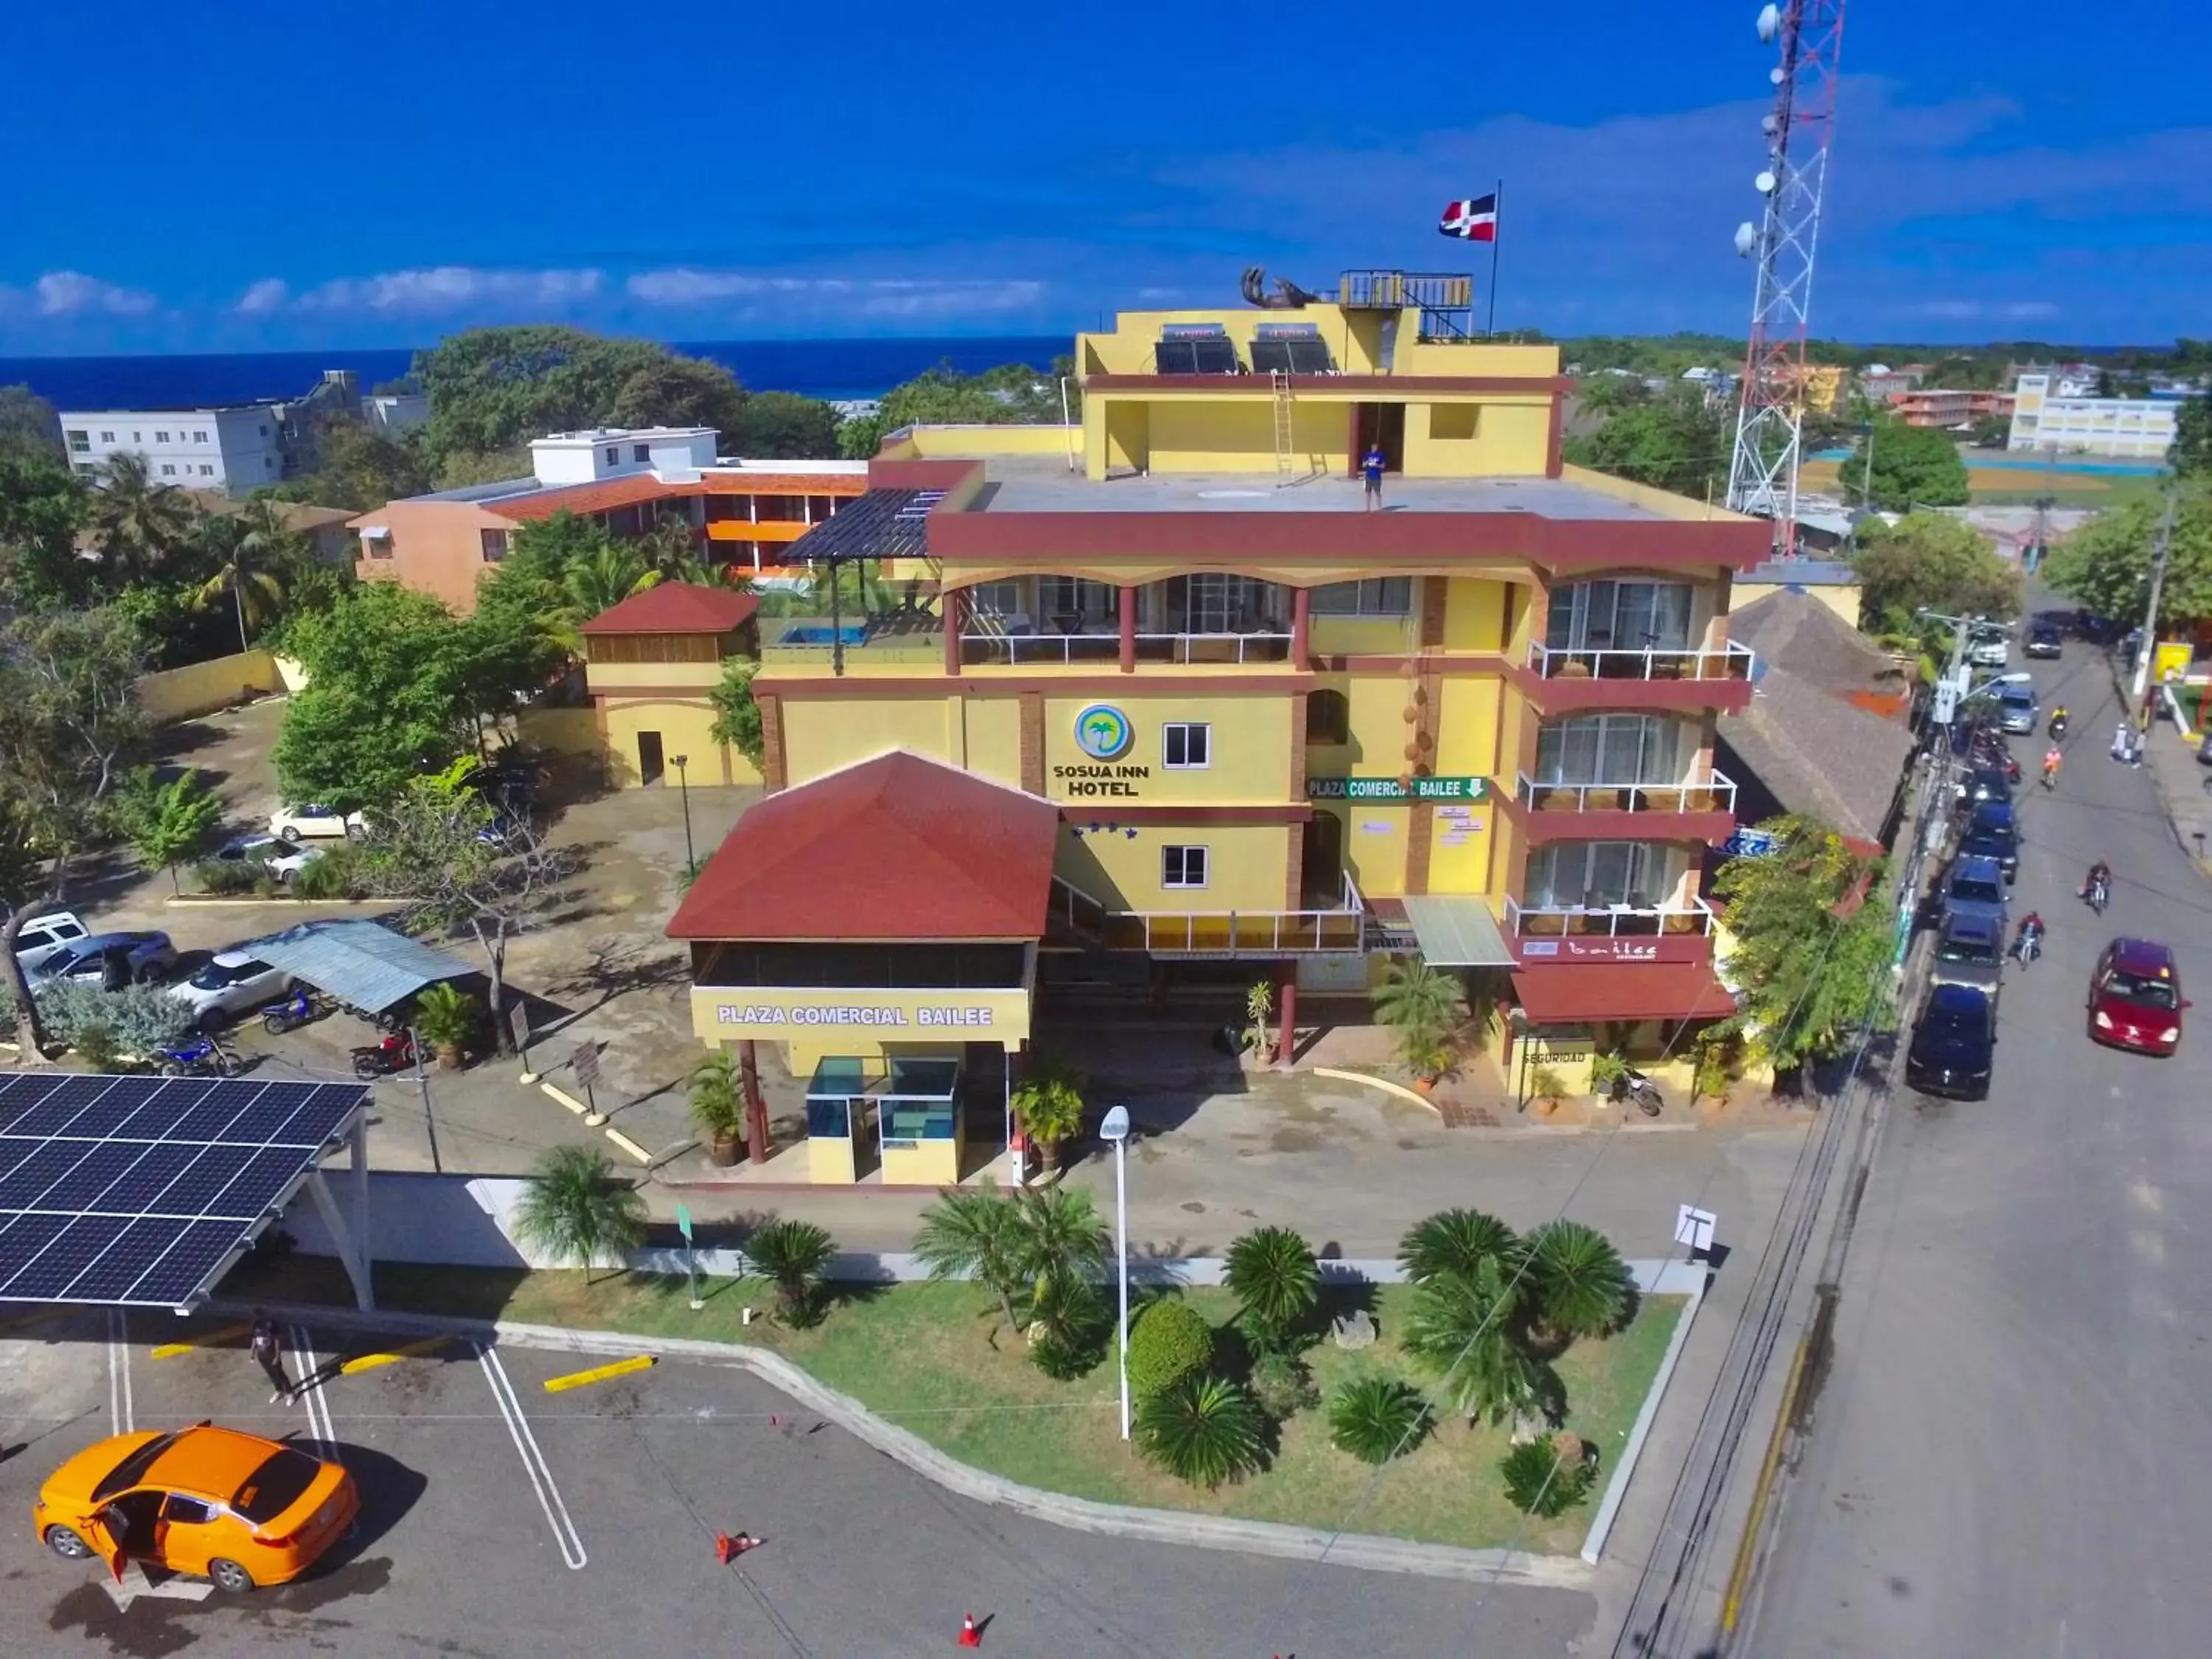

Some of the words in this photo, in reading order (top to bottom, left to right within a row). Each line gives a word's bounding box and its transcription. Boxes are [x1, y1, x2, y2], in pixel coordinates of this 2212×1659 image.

[1053, 765, 1113, 778] SOSUA
[1116, 766, 1150, 778] INN
[1068, 782, 1139, 796] HOTEL
[1310, 779, 1346, 796] PLAZA
[1419, 781, 1461, 796] BAILEE
[718, 1006, 787, 1024] PLAZA
[790, 1006, 908, 1026] COMERCIAL
[917, 1007, 992, 1026] BAILEE
[1523, 1051, 1586, 1063] SEGURIDAD
